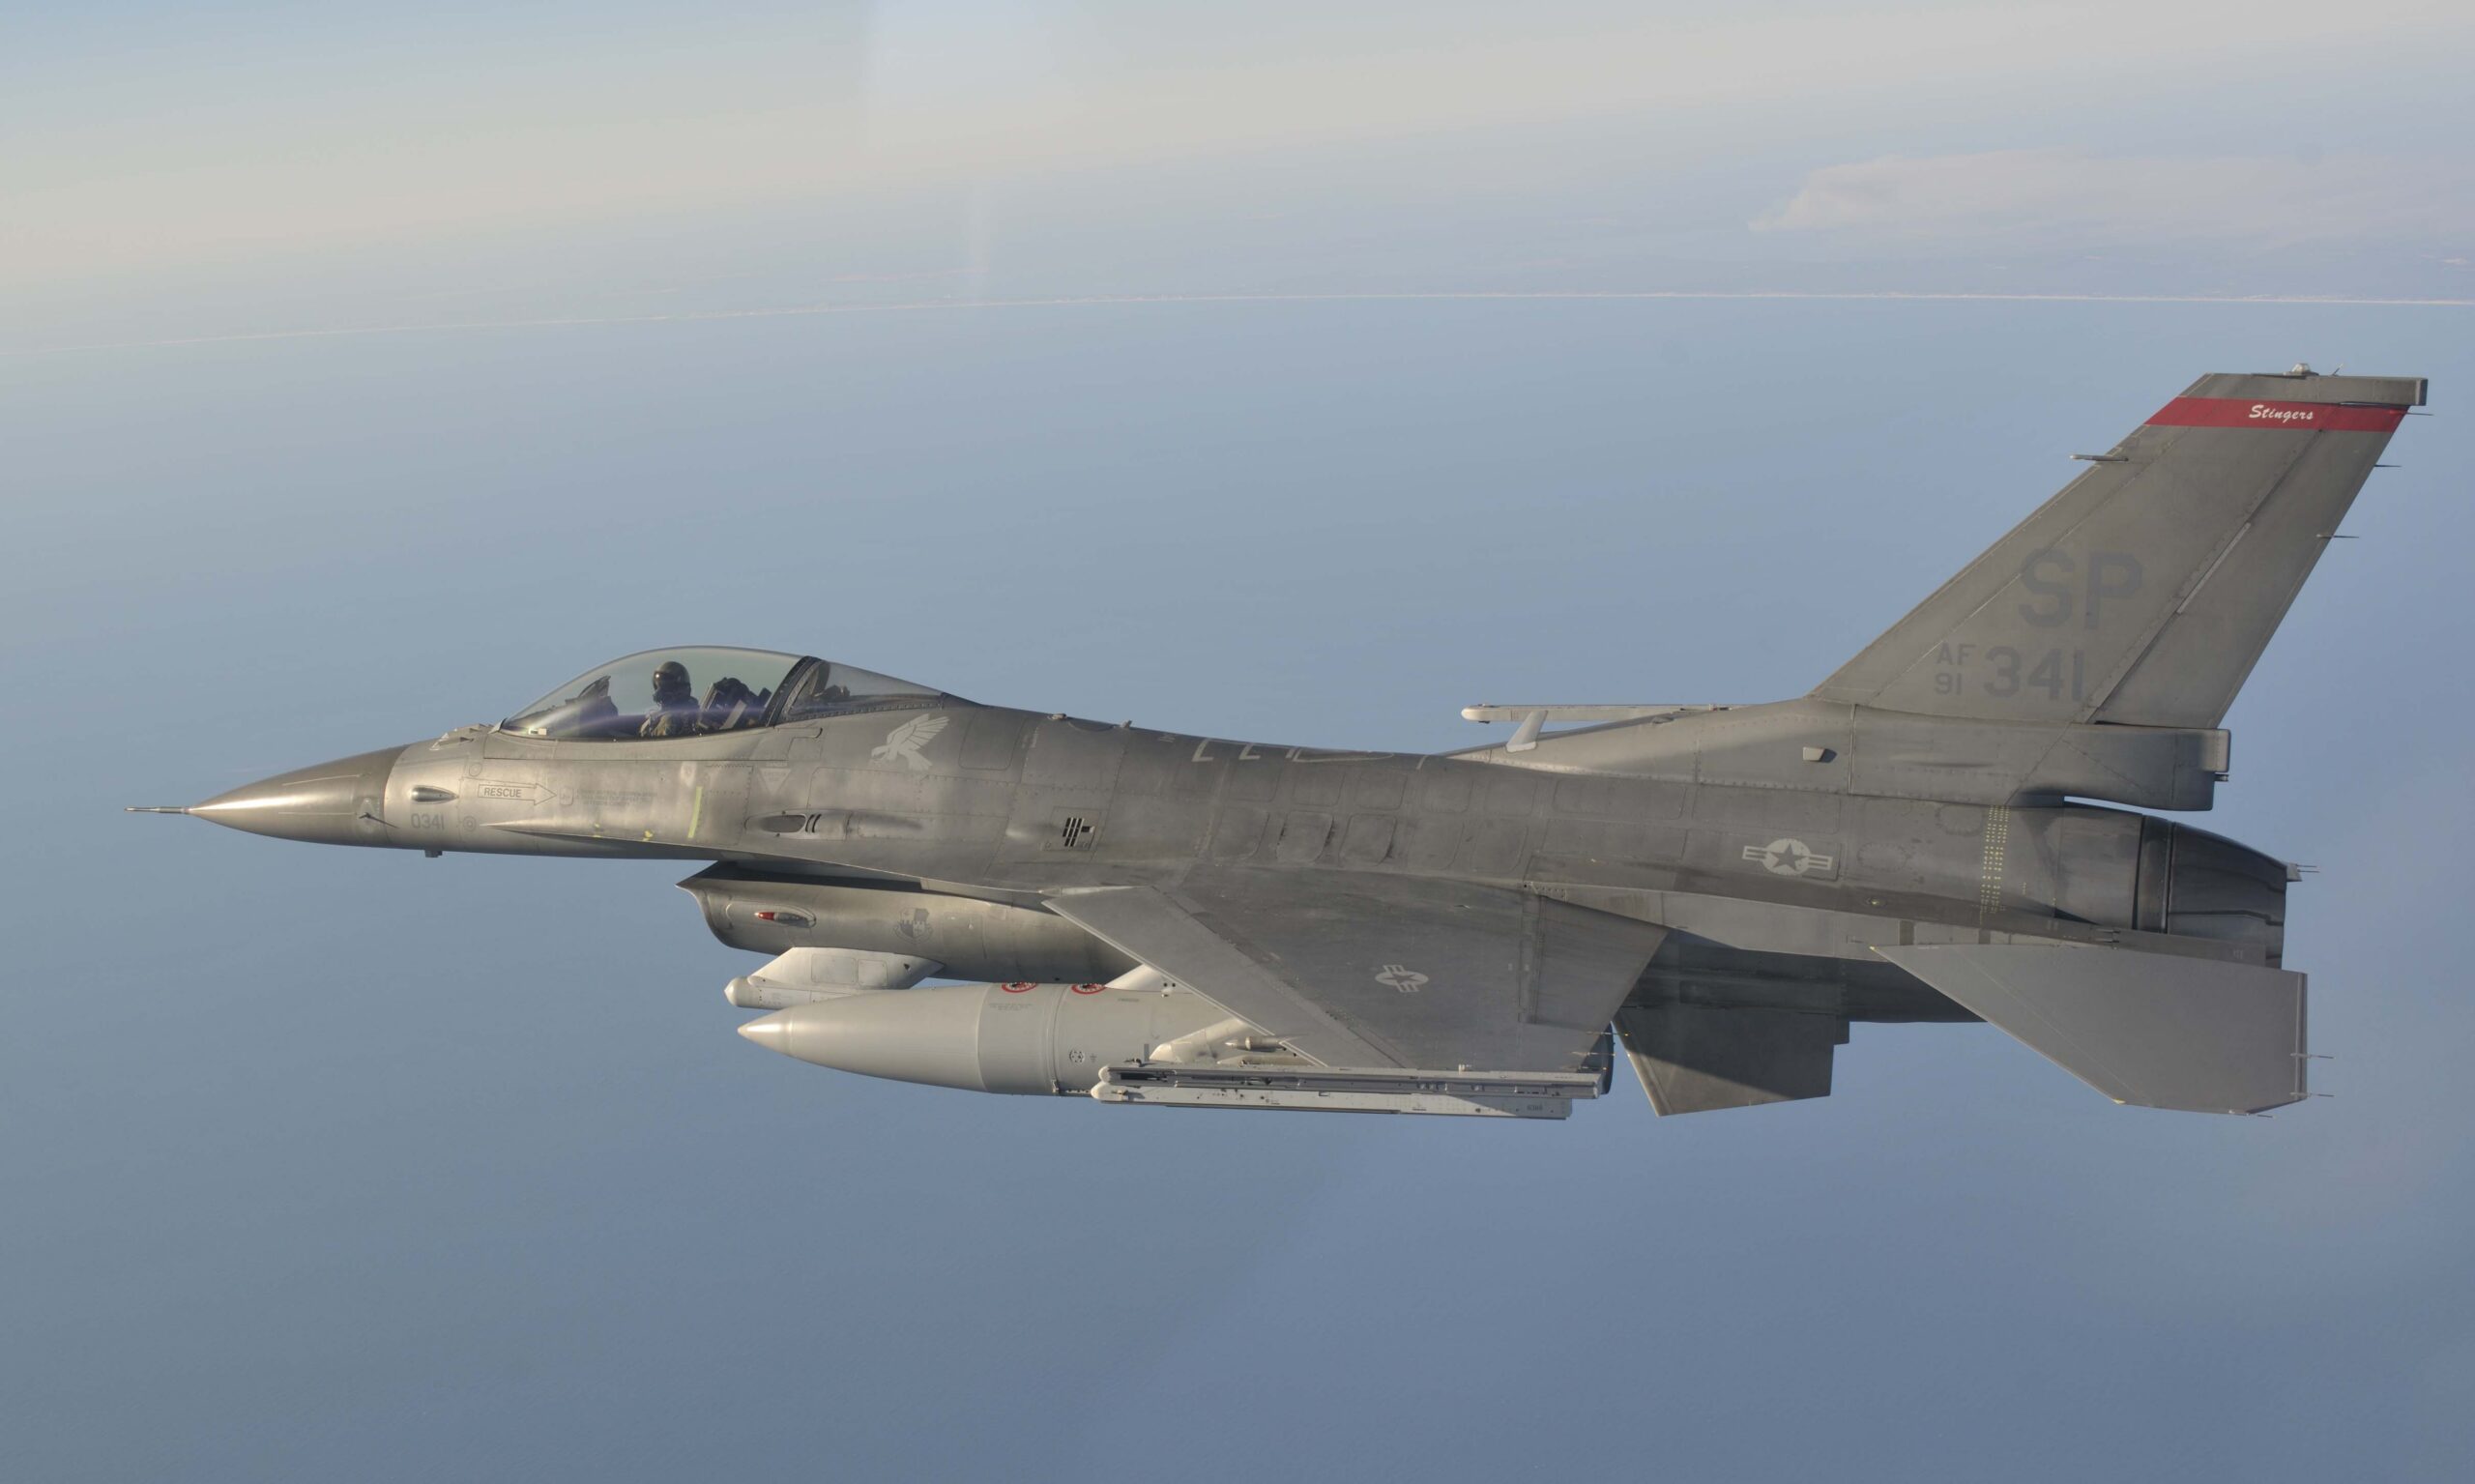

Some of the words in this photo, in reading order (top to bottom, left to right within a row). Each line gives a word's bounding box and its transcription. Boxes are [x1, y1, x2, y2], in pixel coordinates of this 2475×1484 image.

[2248, 403, 2315, 423] Stingers
[2019, 549, 2142, 630] SP
[1936, 643, 1976, 665] AF
[1985, 646, 2083, 702] 341
[1936, 675, 1962, 696] 91
[483, 787, 523, 799] RESCUE
[411, 813, 445, 829] 0341
